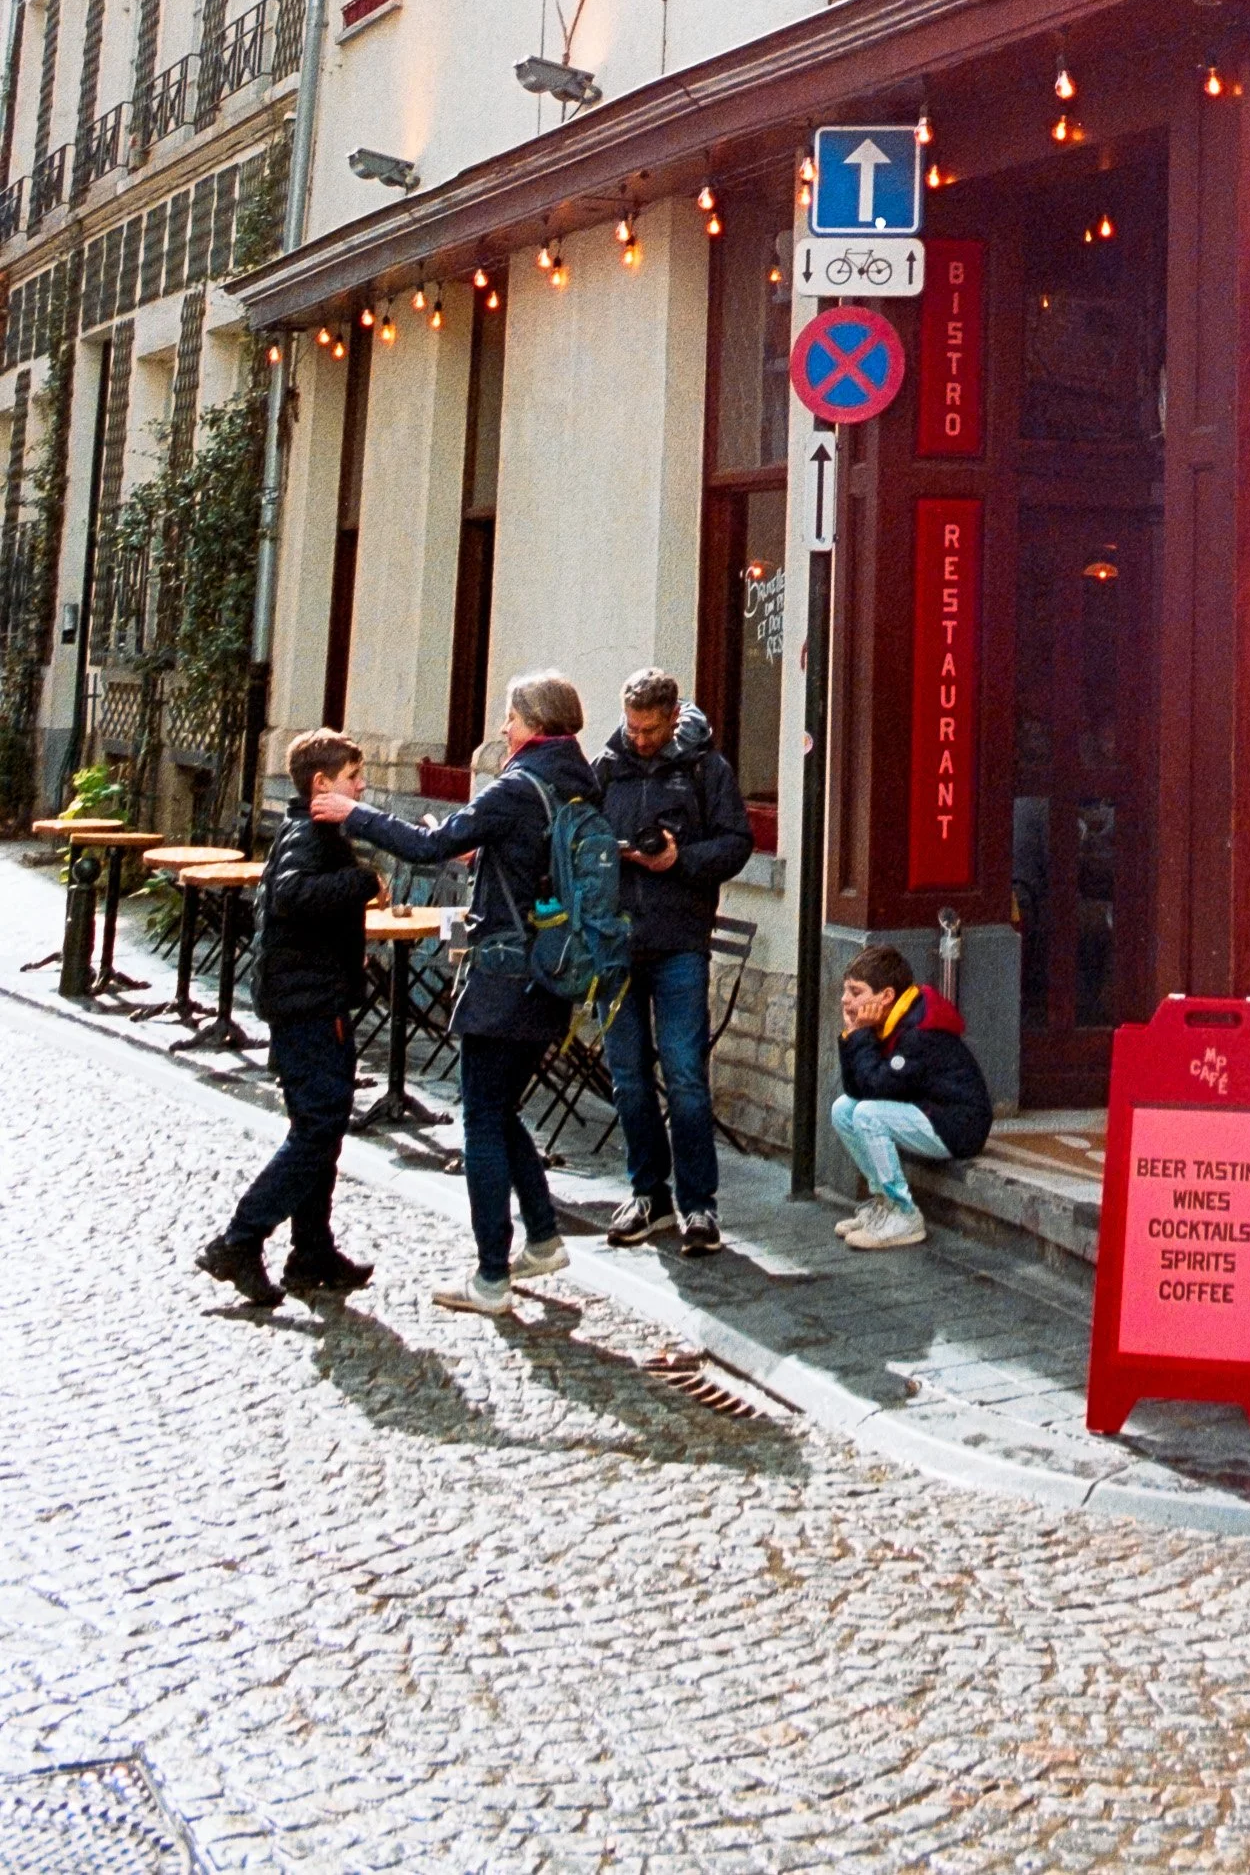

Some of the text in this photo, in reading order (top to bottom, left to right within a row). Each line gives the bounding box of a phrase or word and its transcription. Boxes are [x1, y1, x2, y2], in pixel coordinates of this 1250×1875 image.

[945, 261, 965, 437] BISTRO
[936, 524, 961, 840] RESTAURANT
[1136, 1157, 1187, 1180] BEER
[1172, 1189, 1231, 1212] WINES
[1160, 1248, 1237, 1274] SPIRITS
[1158, 1279, 1236, 1304] COFFEE
